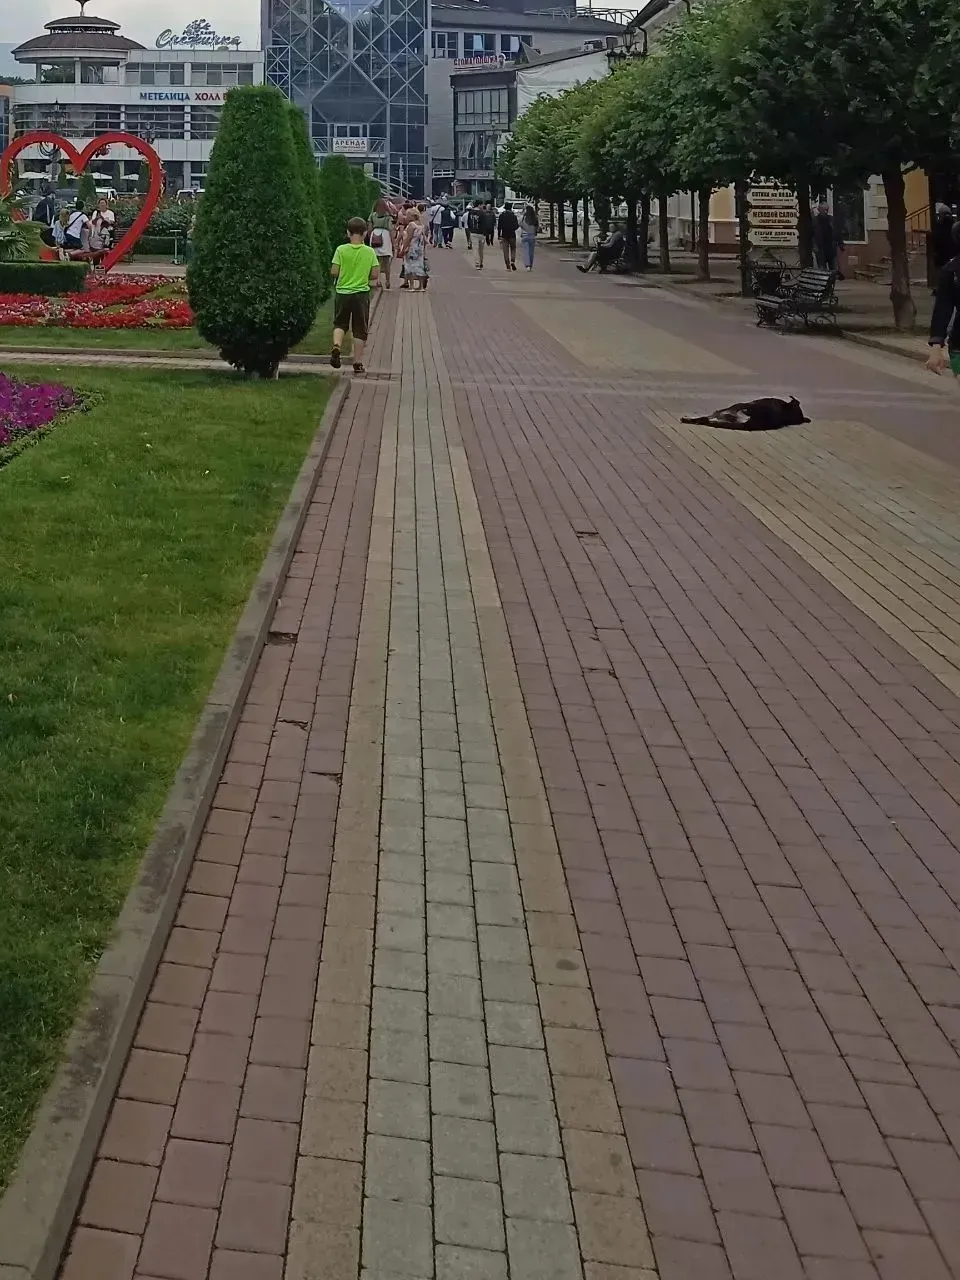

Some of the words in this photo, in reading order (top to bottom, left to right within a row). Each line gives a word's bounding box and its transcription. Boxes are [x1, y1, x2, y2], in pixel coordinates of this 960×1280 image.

[139, 92, 190, 102] МЕТЕЛИЦА
[195, 92, 221, 101] ХОЛЛ
[752, 210, 778, 218] МЕХОВОЙ
